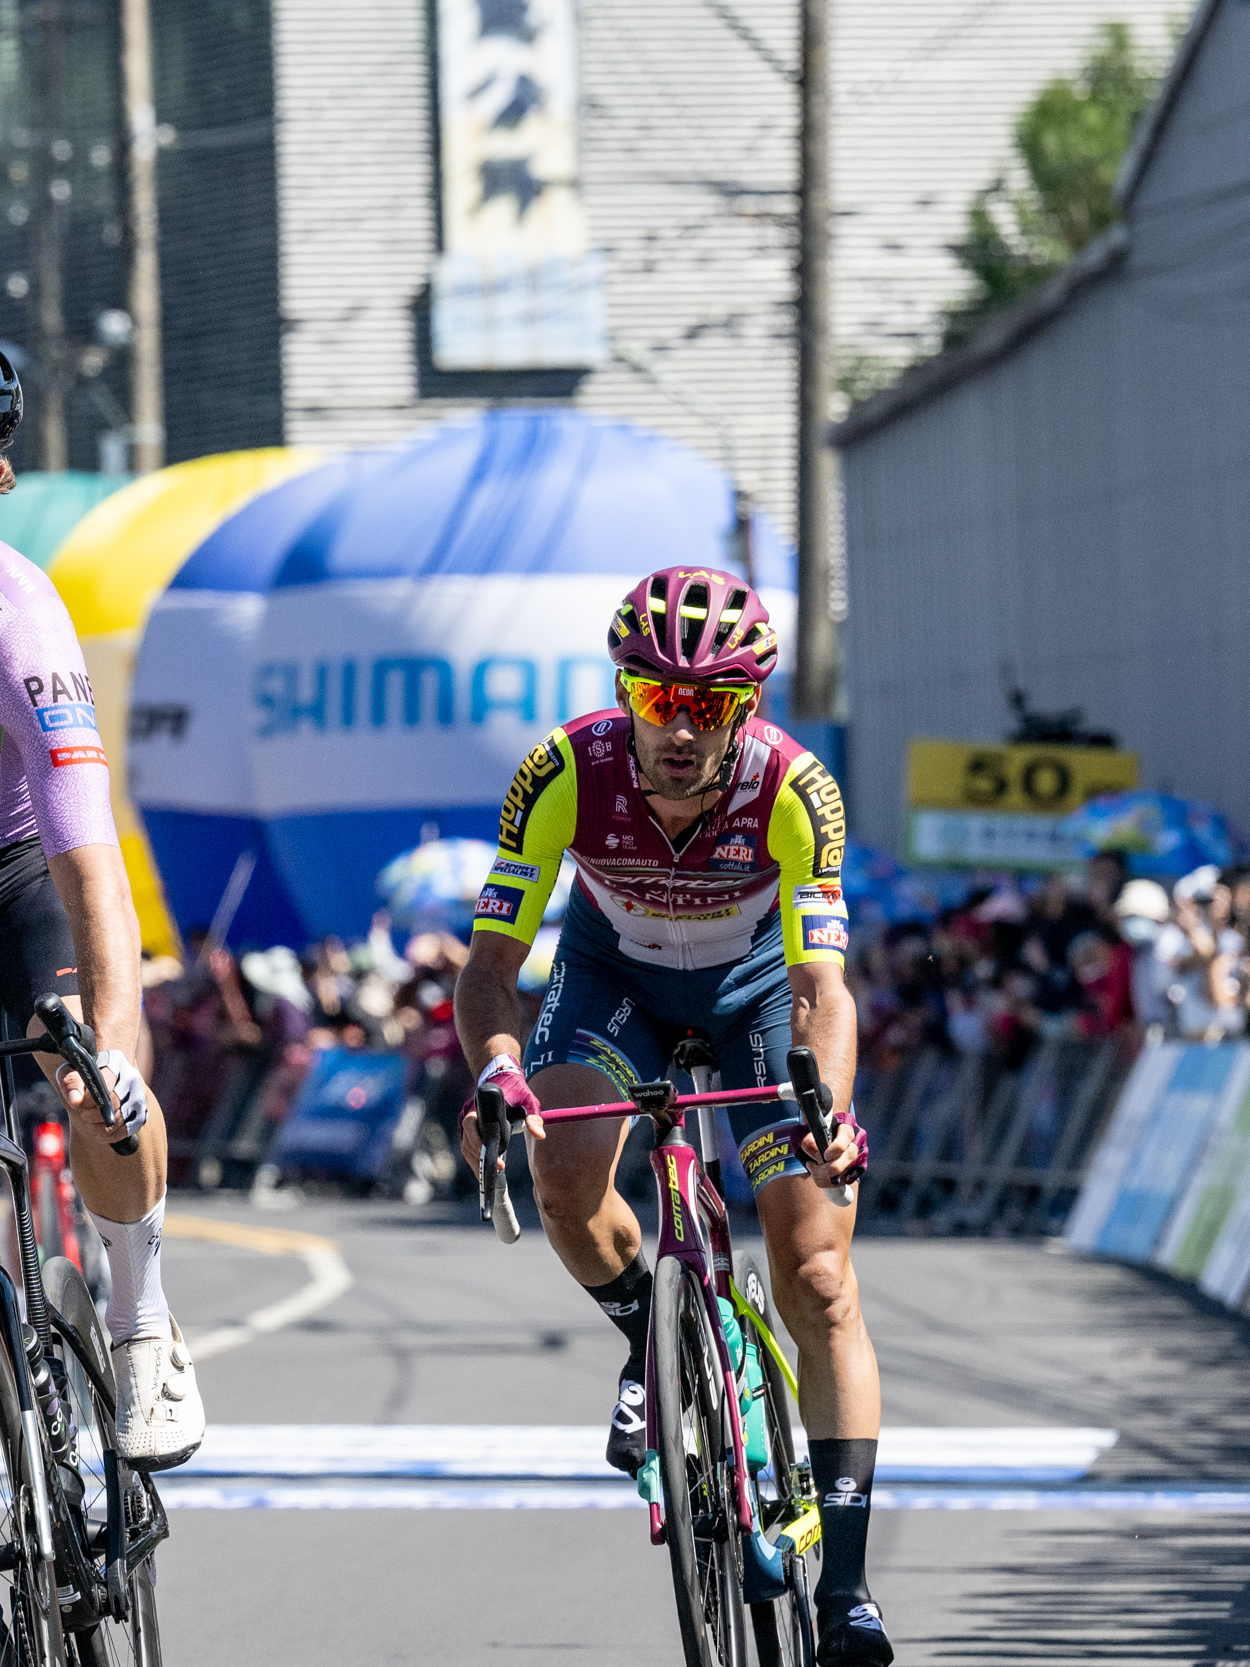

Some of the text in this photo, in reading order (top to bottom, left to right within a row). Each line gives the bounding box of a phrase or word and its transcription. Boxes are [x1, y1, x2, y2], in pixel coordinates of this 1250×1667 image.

[678, 570, 726, 586] LAS
[639, 612, 651, 637] LAS
[727, 627, 745, 650] LAS
[677, 685, 695, 697] NEON
[732, 817, 759, 829] APRA
[712, 845, 753, 862] NERI
[589, 857, 659, 867] NUOVACOMAUTO
[607, 997, 636, 1037] URSUS
[634, 1088, 665, 1099] wahoo
[667, 1154, 685, 1242] corratec
